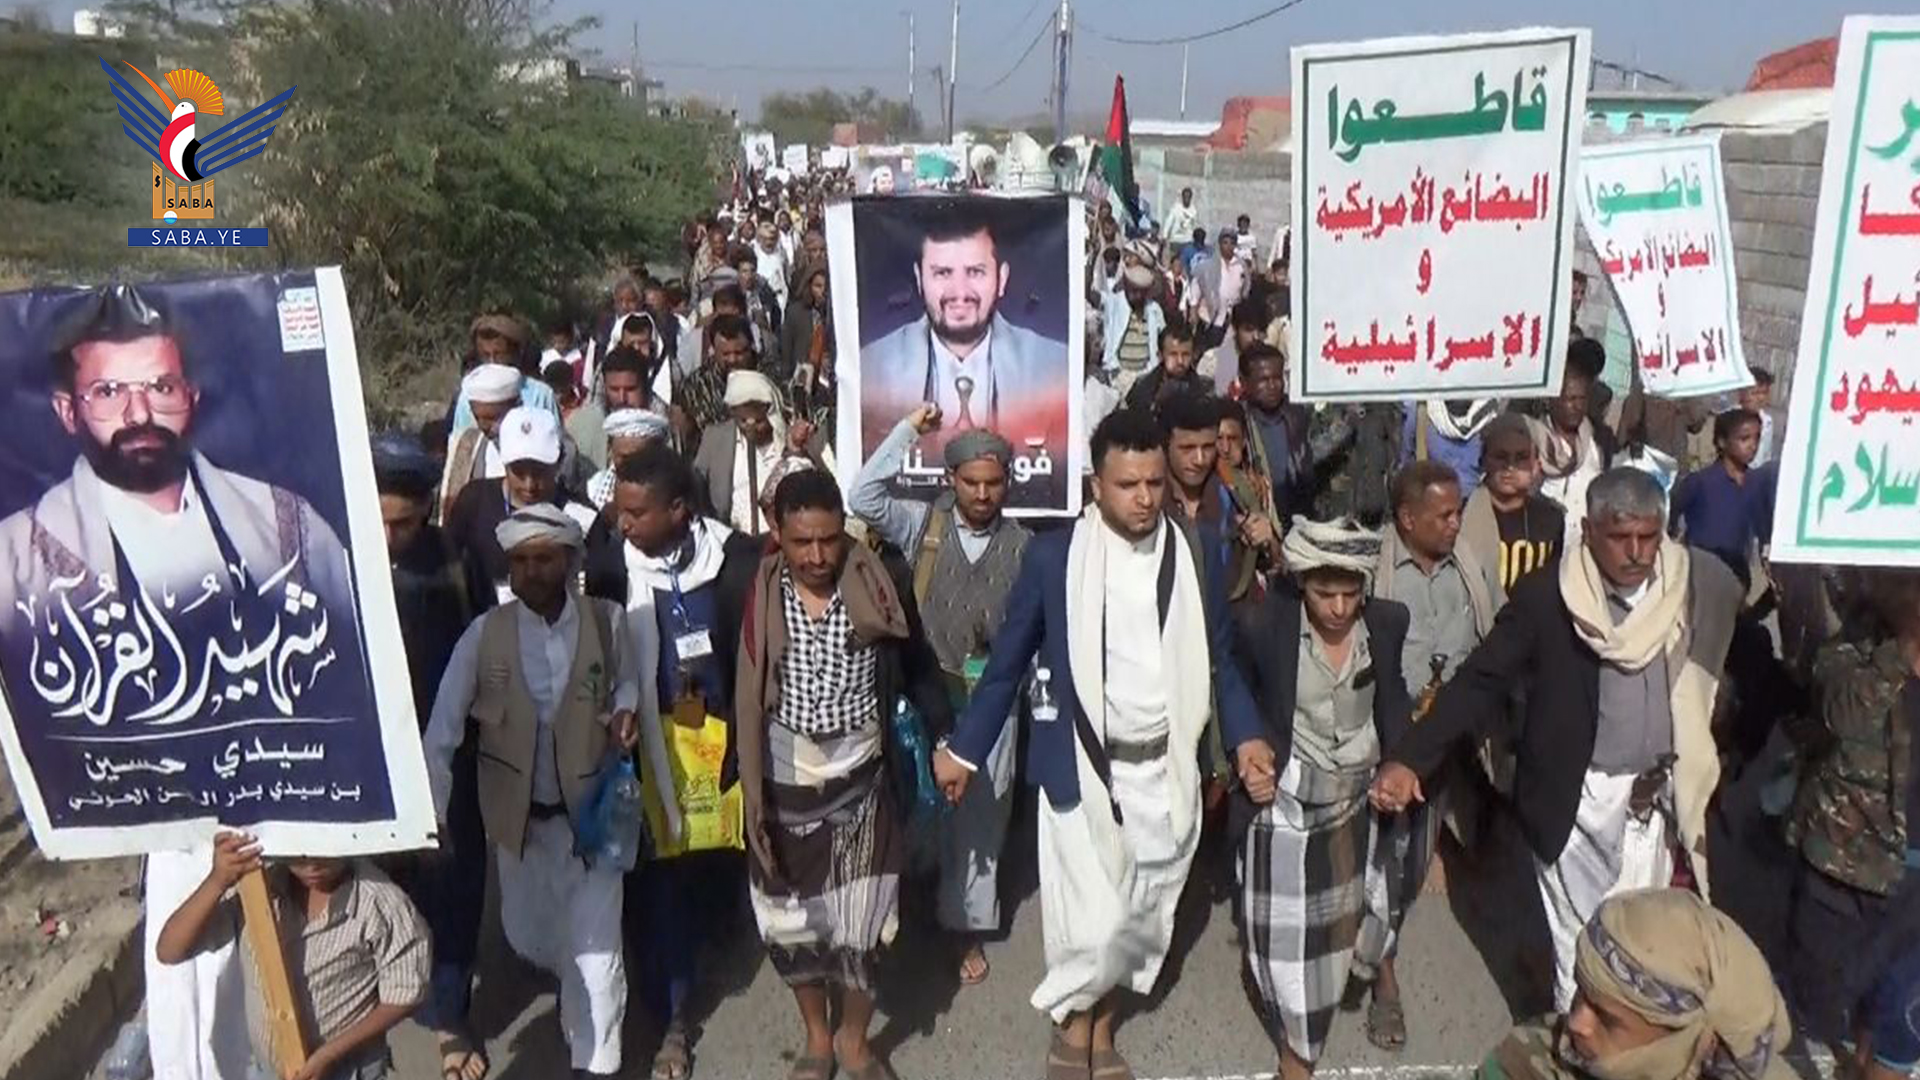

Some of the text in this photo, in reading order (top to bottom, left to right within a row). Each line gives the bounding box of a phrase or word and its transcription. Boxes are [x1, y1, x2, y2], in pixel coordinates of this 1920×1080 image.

[1328, 65, 1547, 162] قاطعوا
[1316, 165, 1549, 240] البضائع الأمريكية
[1584, 161, 1703, 229] قاطعوا
[1417, 249, 1432, 294] و
[1658, 282, 1666, 318] و
[1322, 311, 1541, 375] الإسرائيلية
[144, 553, 337, 724] شهيد
[85, 737, 324, 782] سيدي حسين
[68, 781, 361, 810] بن سيدي بدر الن الحوثي
